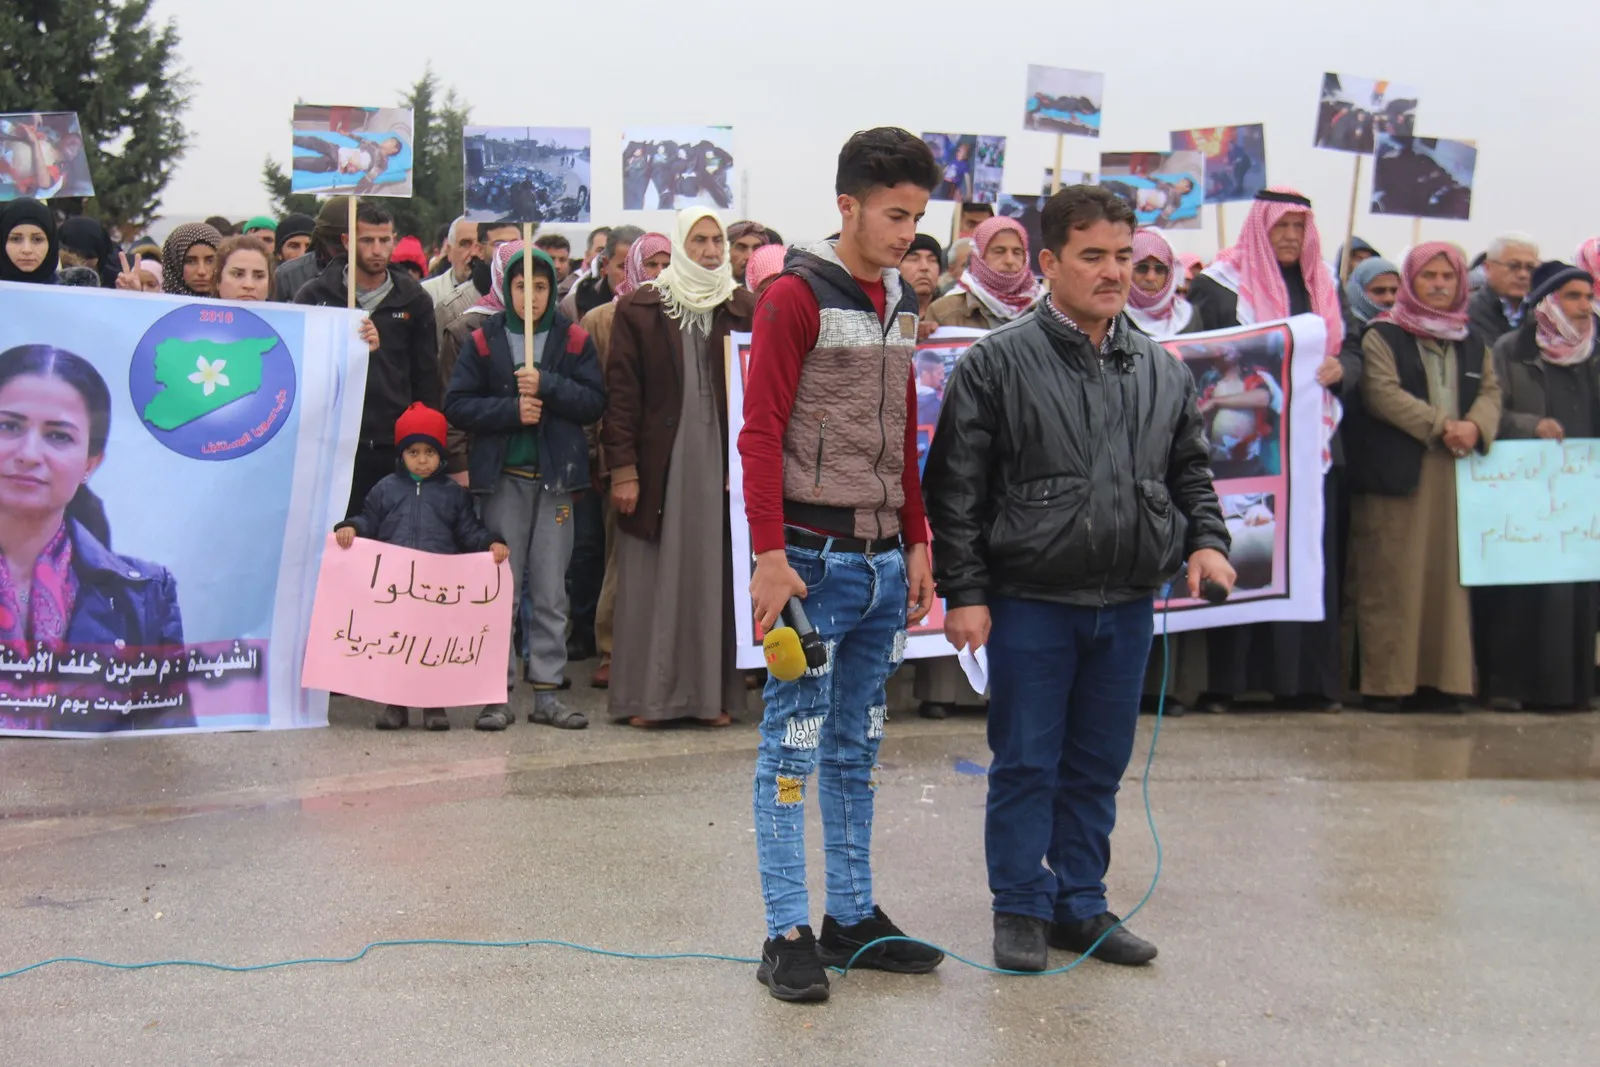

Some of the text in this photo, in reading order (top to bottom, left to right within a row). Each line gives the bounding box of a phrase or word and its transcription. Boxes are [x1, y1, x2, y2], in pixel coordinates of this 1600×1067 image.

[199, 309, 233, 323] 2018
[57, 650, 102, 675] خلف
[105, 651, 158, 685] هفرين
[187, 640, 258, 678] الشهيدة
[0, 691, 184, 716] استشهدت يوم السبت
